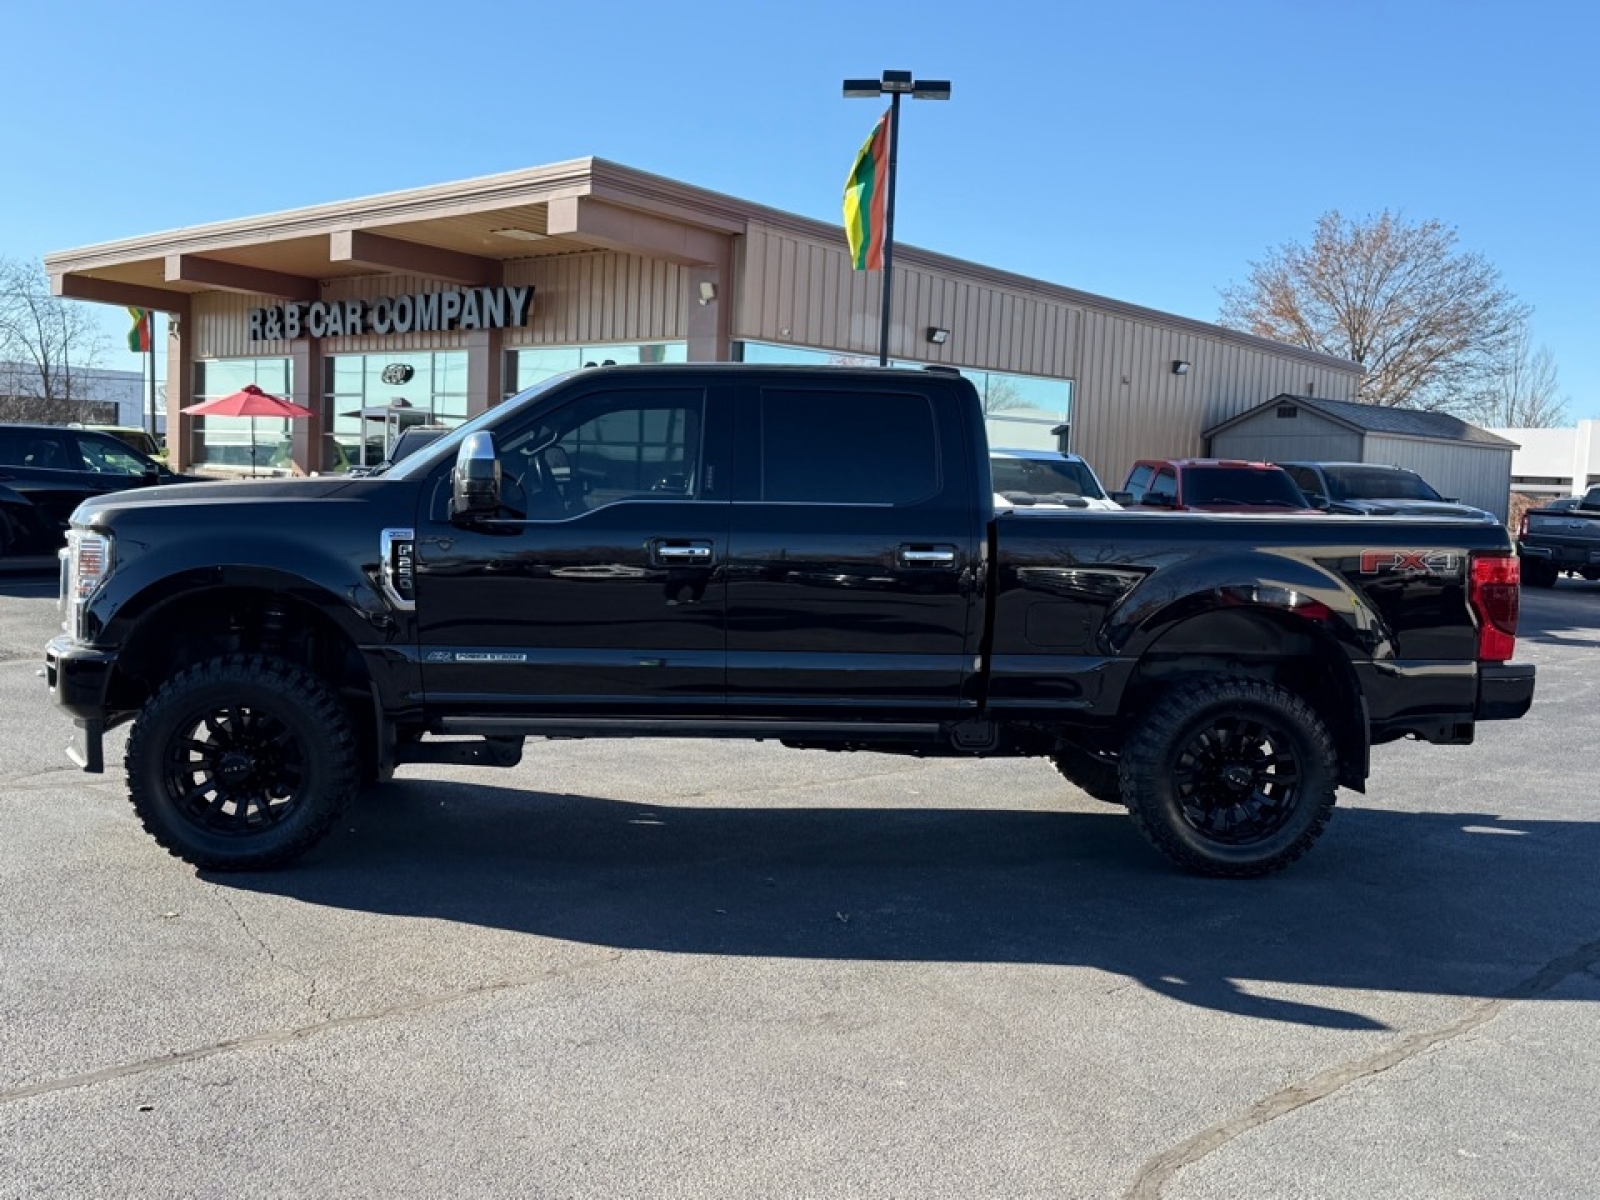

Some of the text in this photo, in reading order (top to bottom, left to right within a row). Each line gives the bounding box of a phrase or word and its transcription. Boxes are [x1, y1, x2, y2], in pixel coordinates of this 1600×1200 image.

[249, 286, 530, 340] R&B CAR COMPANY
[1360, 549, 1459, 575] FX4
